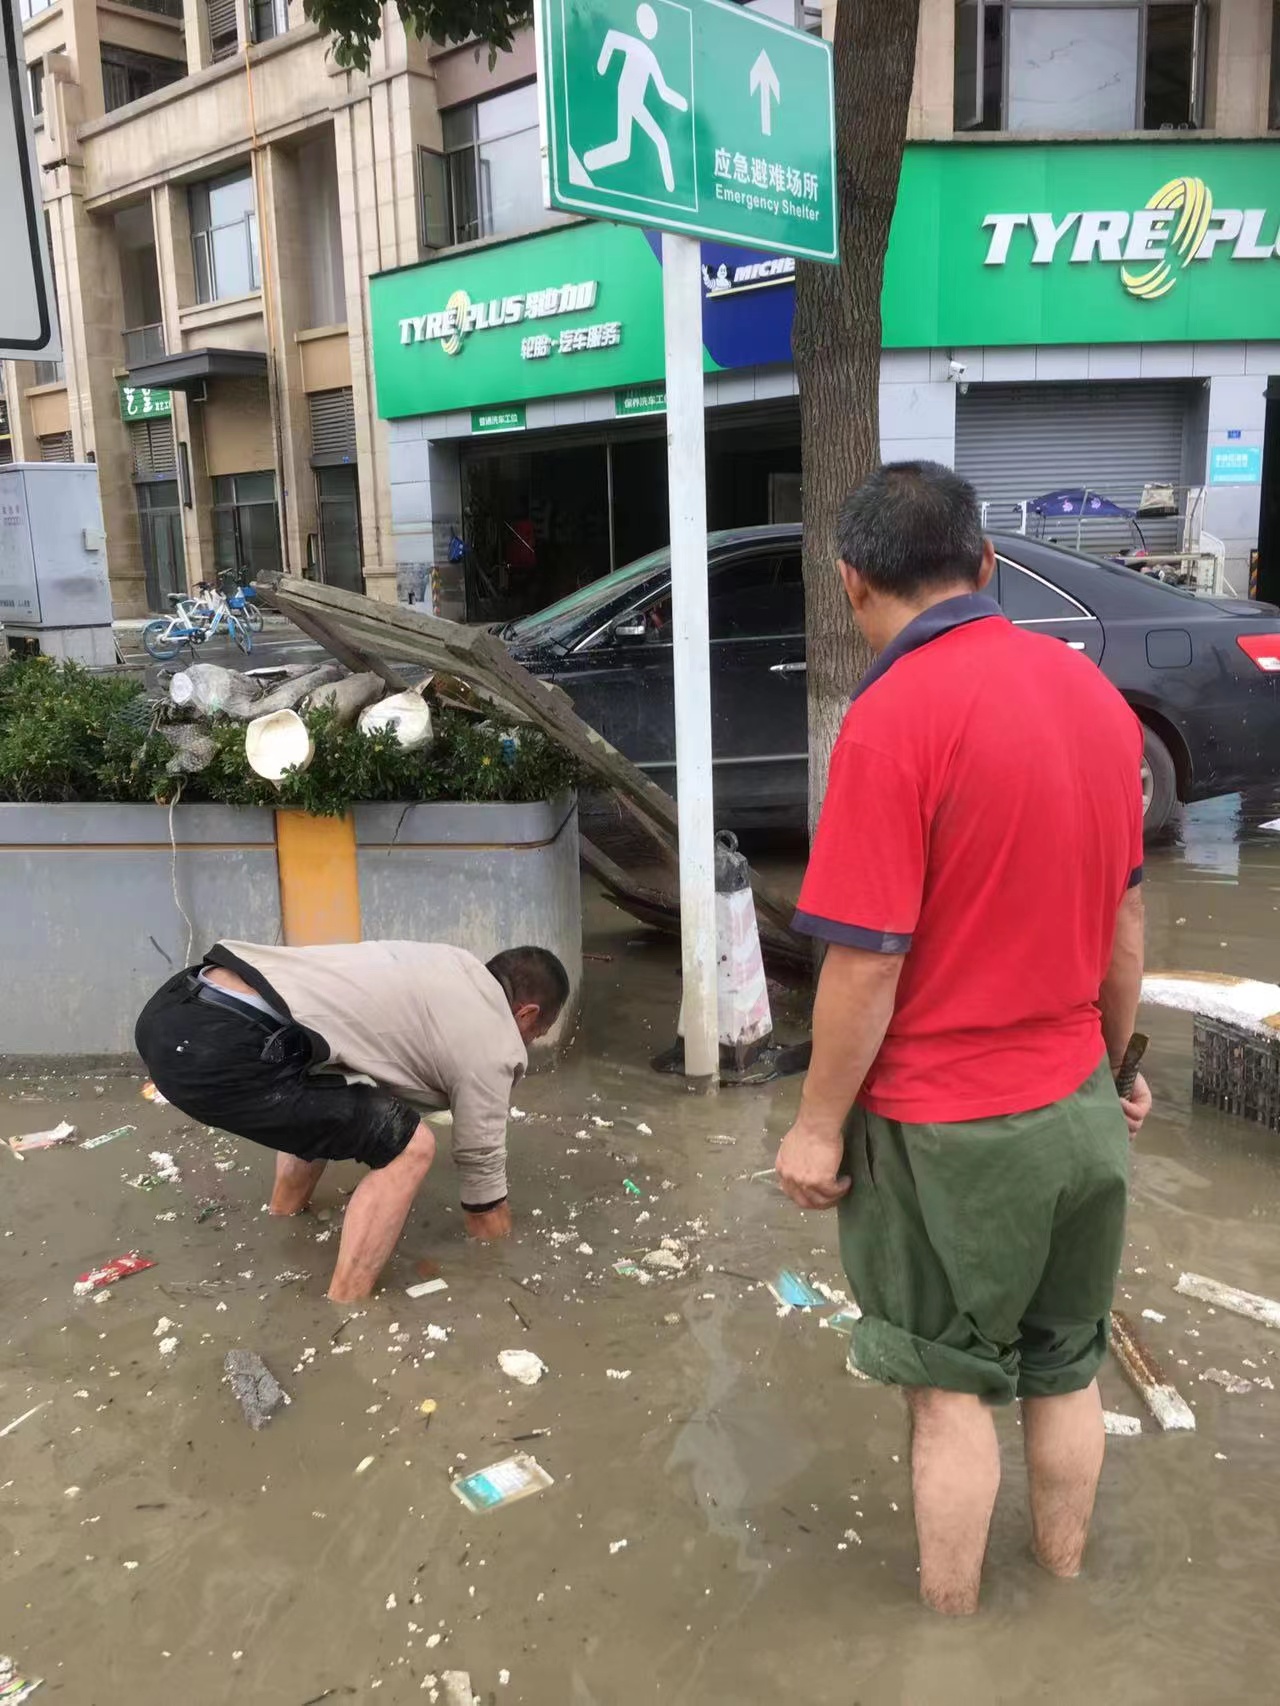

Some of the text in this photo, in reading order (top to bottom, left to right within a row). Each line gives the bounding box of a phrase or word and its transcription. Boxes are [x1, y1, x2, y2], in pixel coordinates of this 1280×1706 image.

[714, 147, 819, 202] 应急避难场所
[715, 183, 820, 221] Emergency Shelter
[981, 208, 1280, 264] TYREPL
[398, 280, 599, 345] TYREPLUS 驰加
